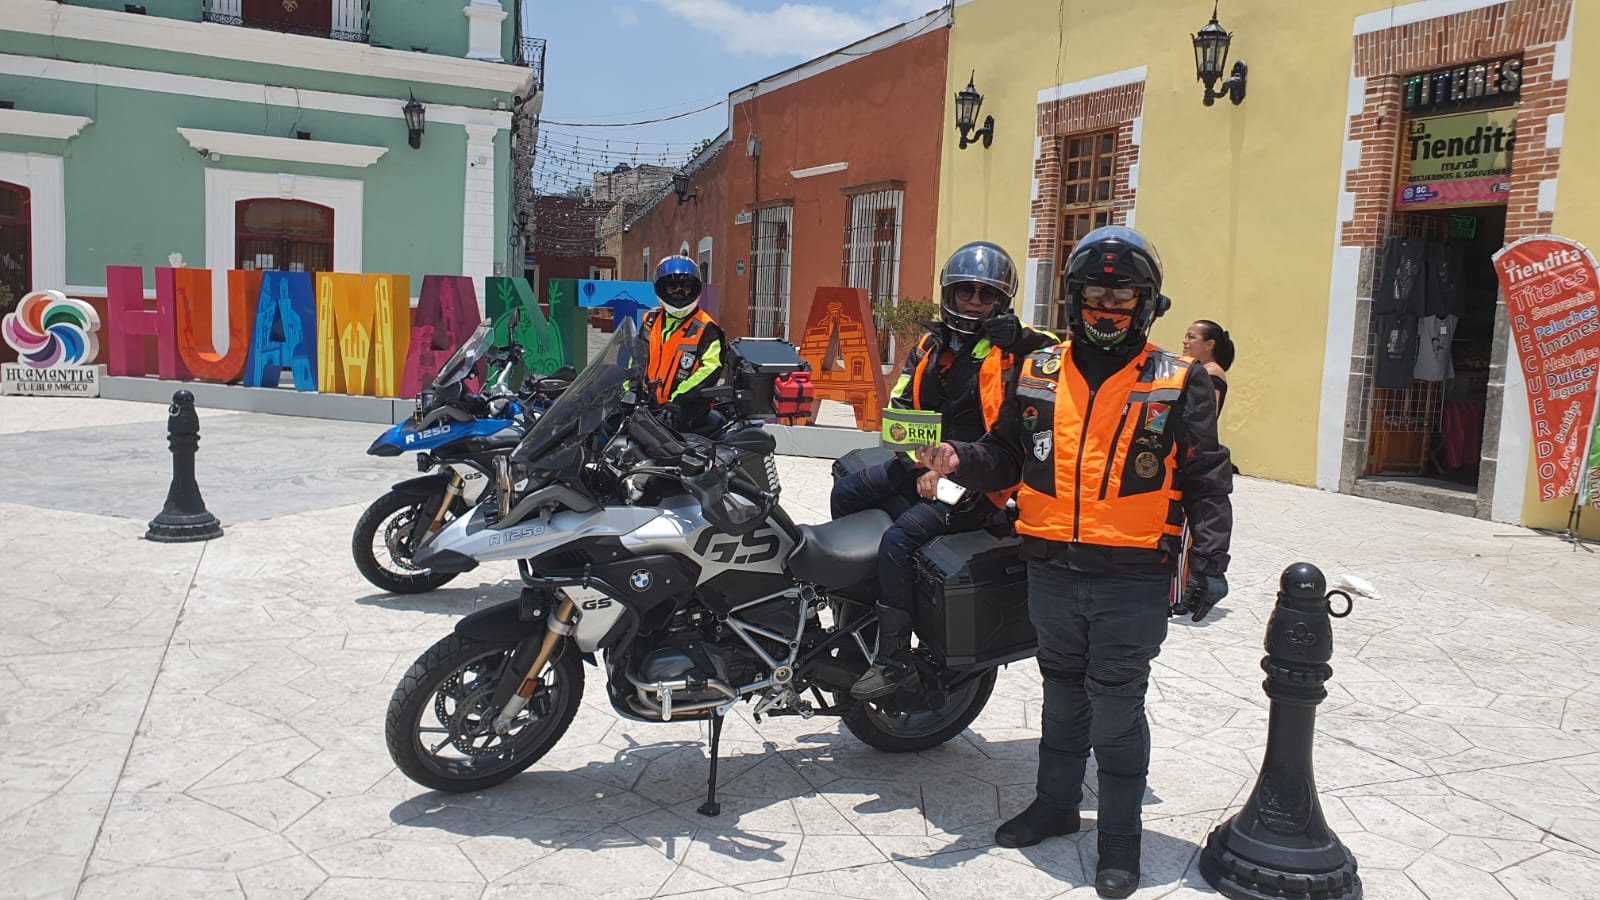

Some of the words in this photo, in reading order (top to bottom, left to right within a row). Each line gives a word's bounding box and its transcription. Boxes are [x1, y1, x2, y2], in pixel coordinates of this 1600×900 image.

[1502, 259, 1516, 269] La
[1505, 249, 1582, 283] Tiendita
[1534, 305, 1598, 340] Peluches
[107, 265, 888, 432] HUAMANTA
[1538, 319, 1600, 358] Imanes
[1554, 401, 1581, 444] Bebidas
[406, 434, 415, 444] R
[418, 425, 451, 440] 1250
[909, 428, 937, 441] RRM
[464, 472, 483, 480] GS
[489, 534, 500, 546] R
[504, 524, 546, 542] 1250
[582, 597, 612, 611] GS
